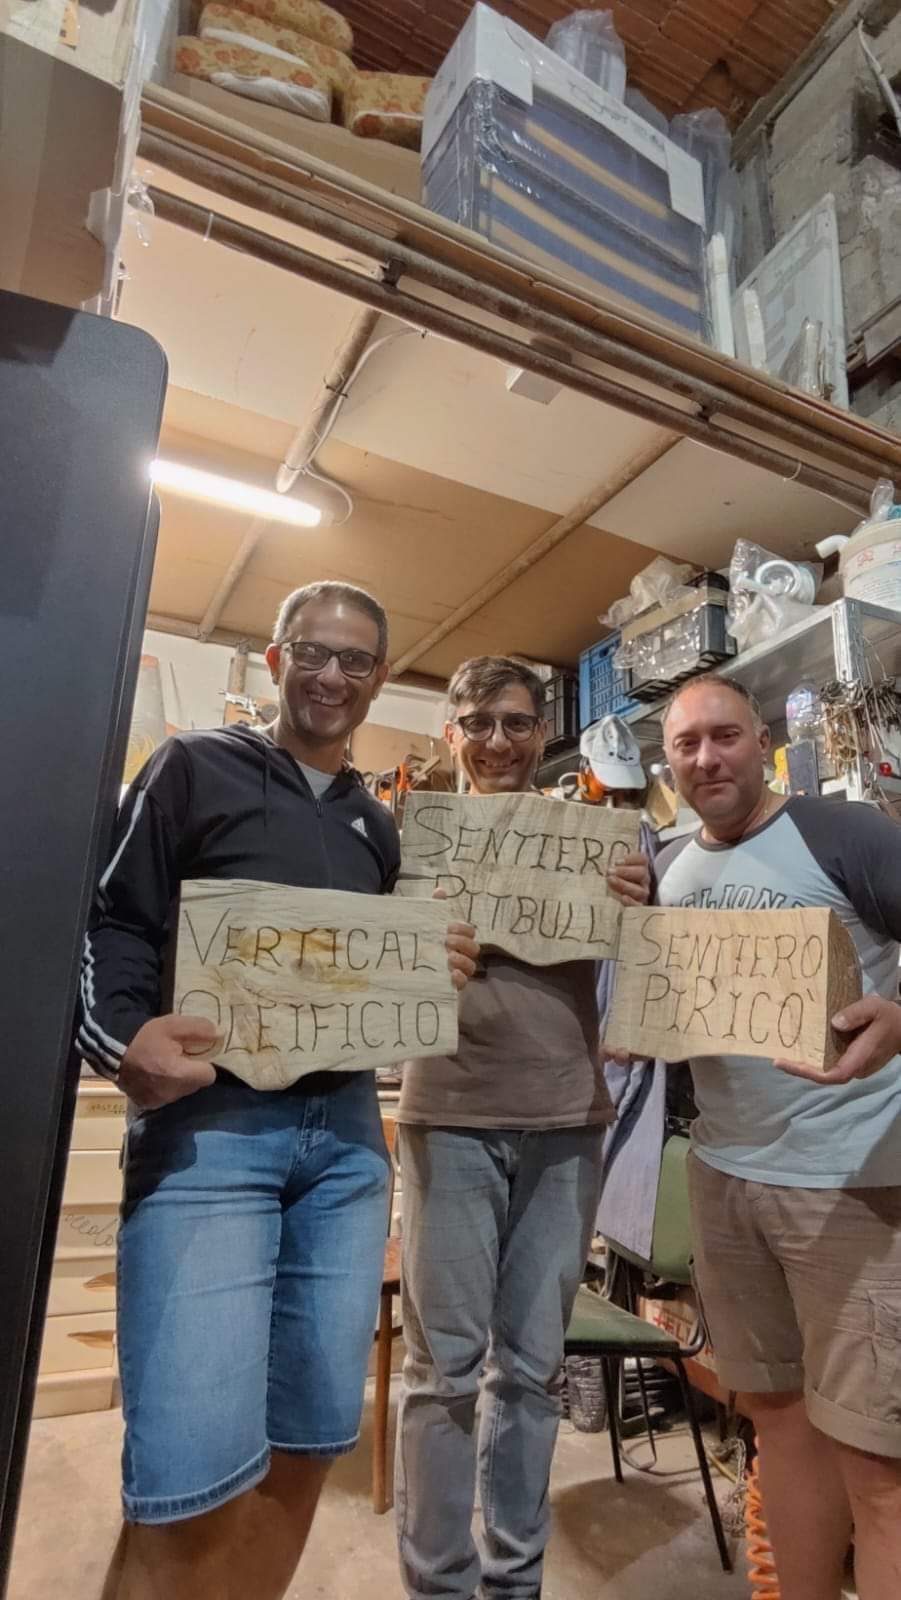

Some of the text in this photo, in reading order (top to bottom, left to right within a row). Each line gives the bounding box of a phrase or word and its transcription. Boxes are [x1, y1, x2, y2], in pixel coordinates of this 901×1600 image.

[414, 805, 631, 876] SENTIERO
[183, 907, 437, 972] VERTICAL
[435, 874, 611, 946] PITBULL
[635, 912, 823, 980] SENTIERO
[179, 989, 440, 1056] OLEIFICIO
